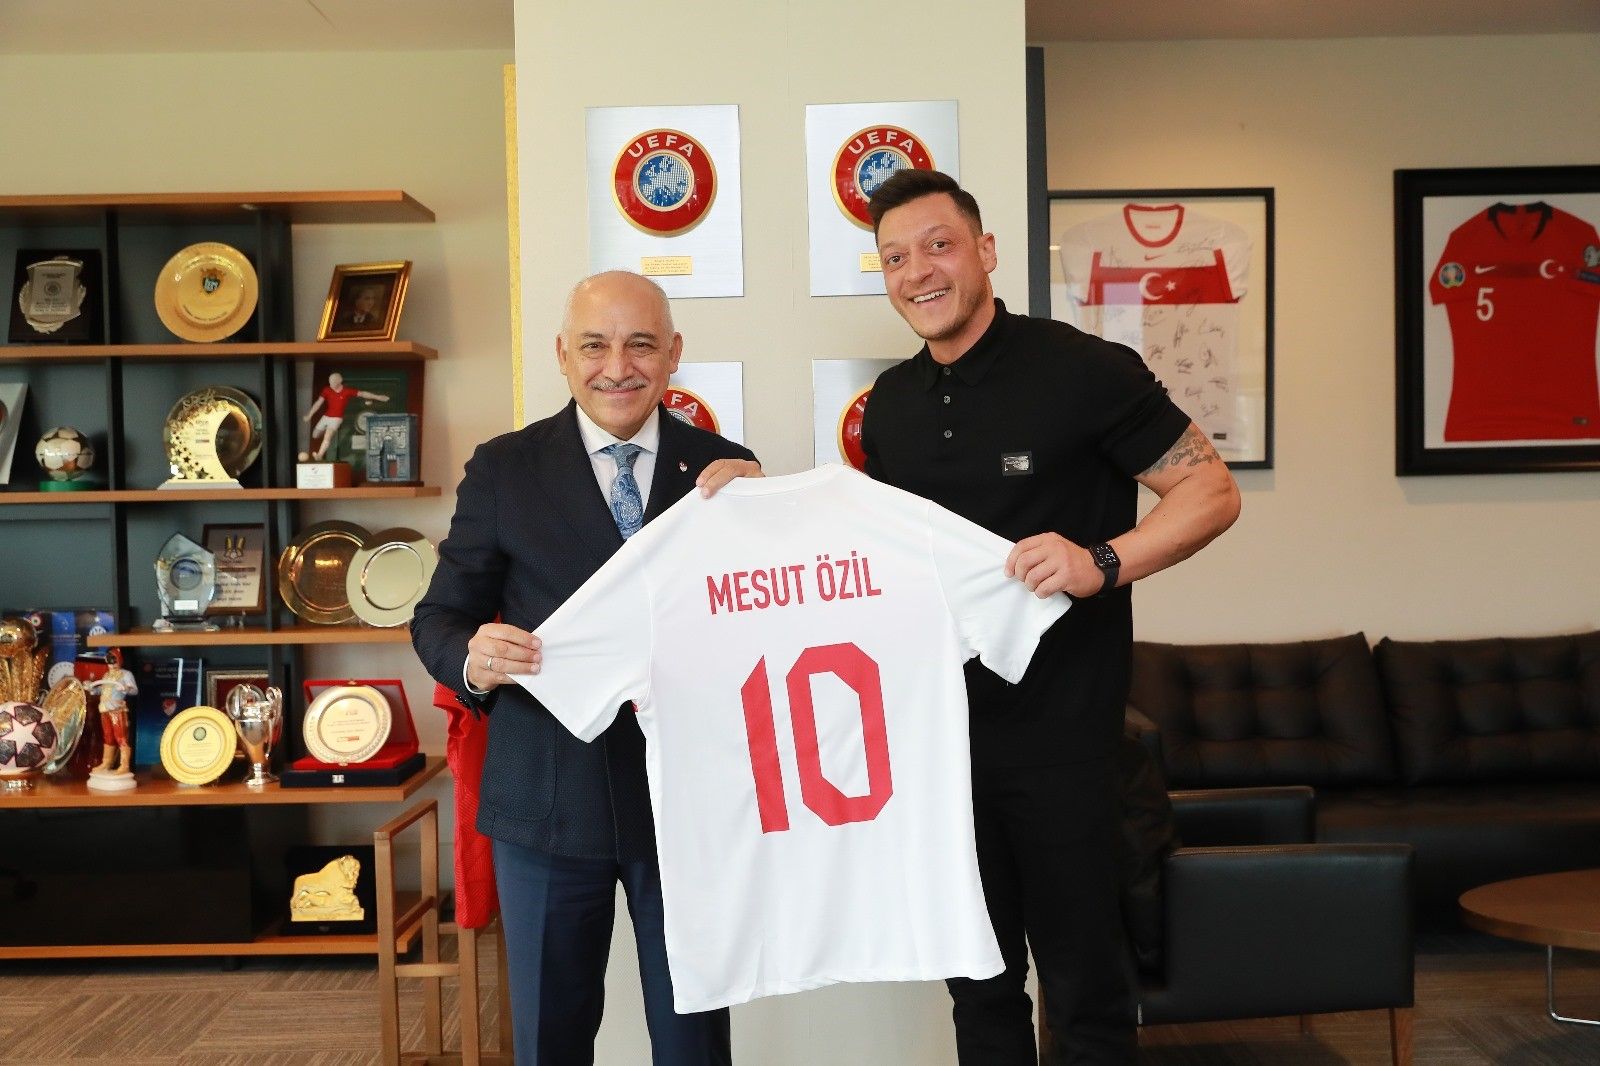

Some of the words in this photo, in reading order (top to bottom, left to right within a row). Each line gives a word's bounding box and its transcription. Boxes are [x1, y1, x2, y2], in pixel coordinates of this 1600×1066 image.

[627, 134, 694, 158] UEFA
[847, 130, 914, 154] UEFA
[1476, 287, 1495, 321] 5
[706, 564, 806, 615] MESUT
[816, 550, 882, 602] ÖZİL
[740, 641, 894, 835] 10
